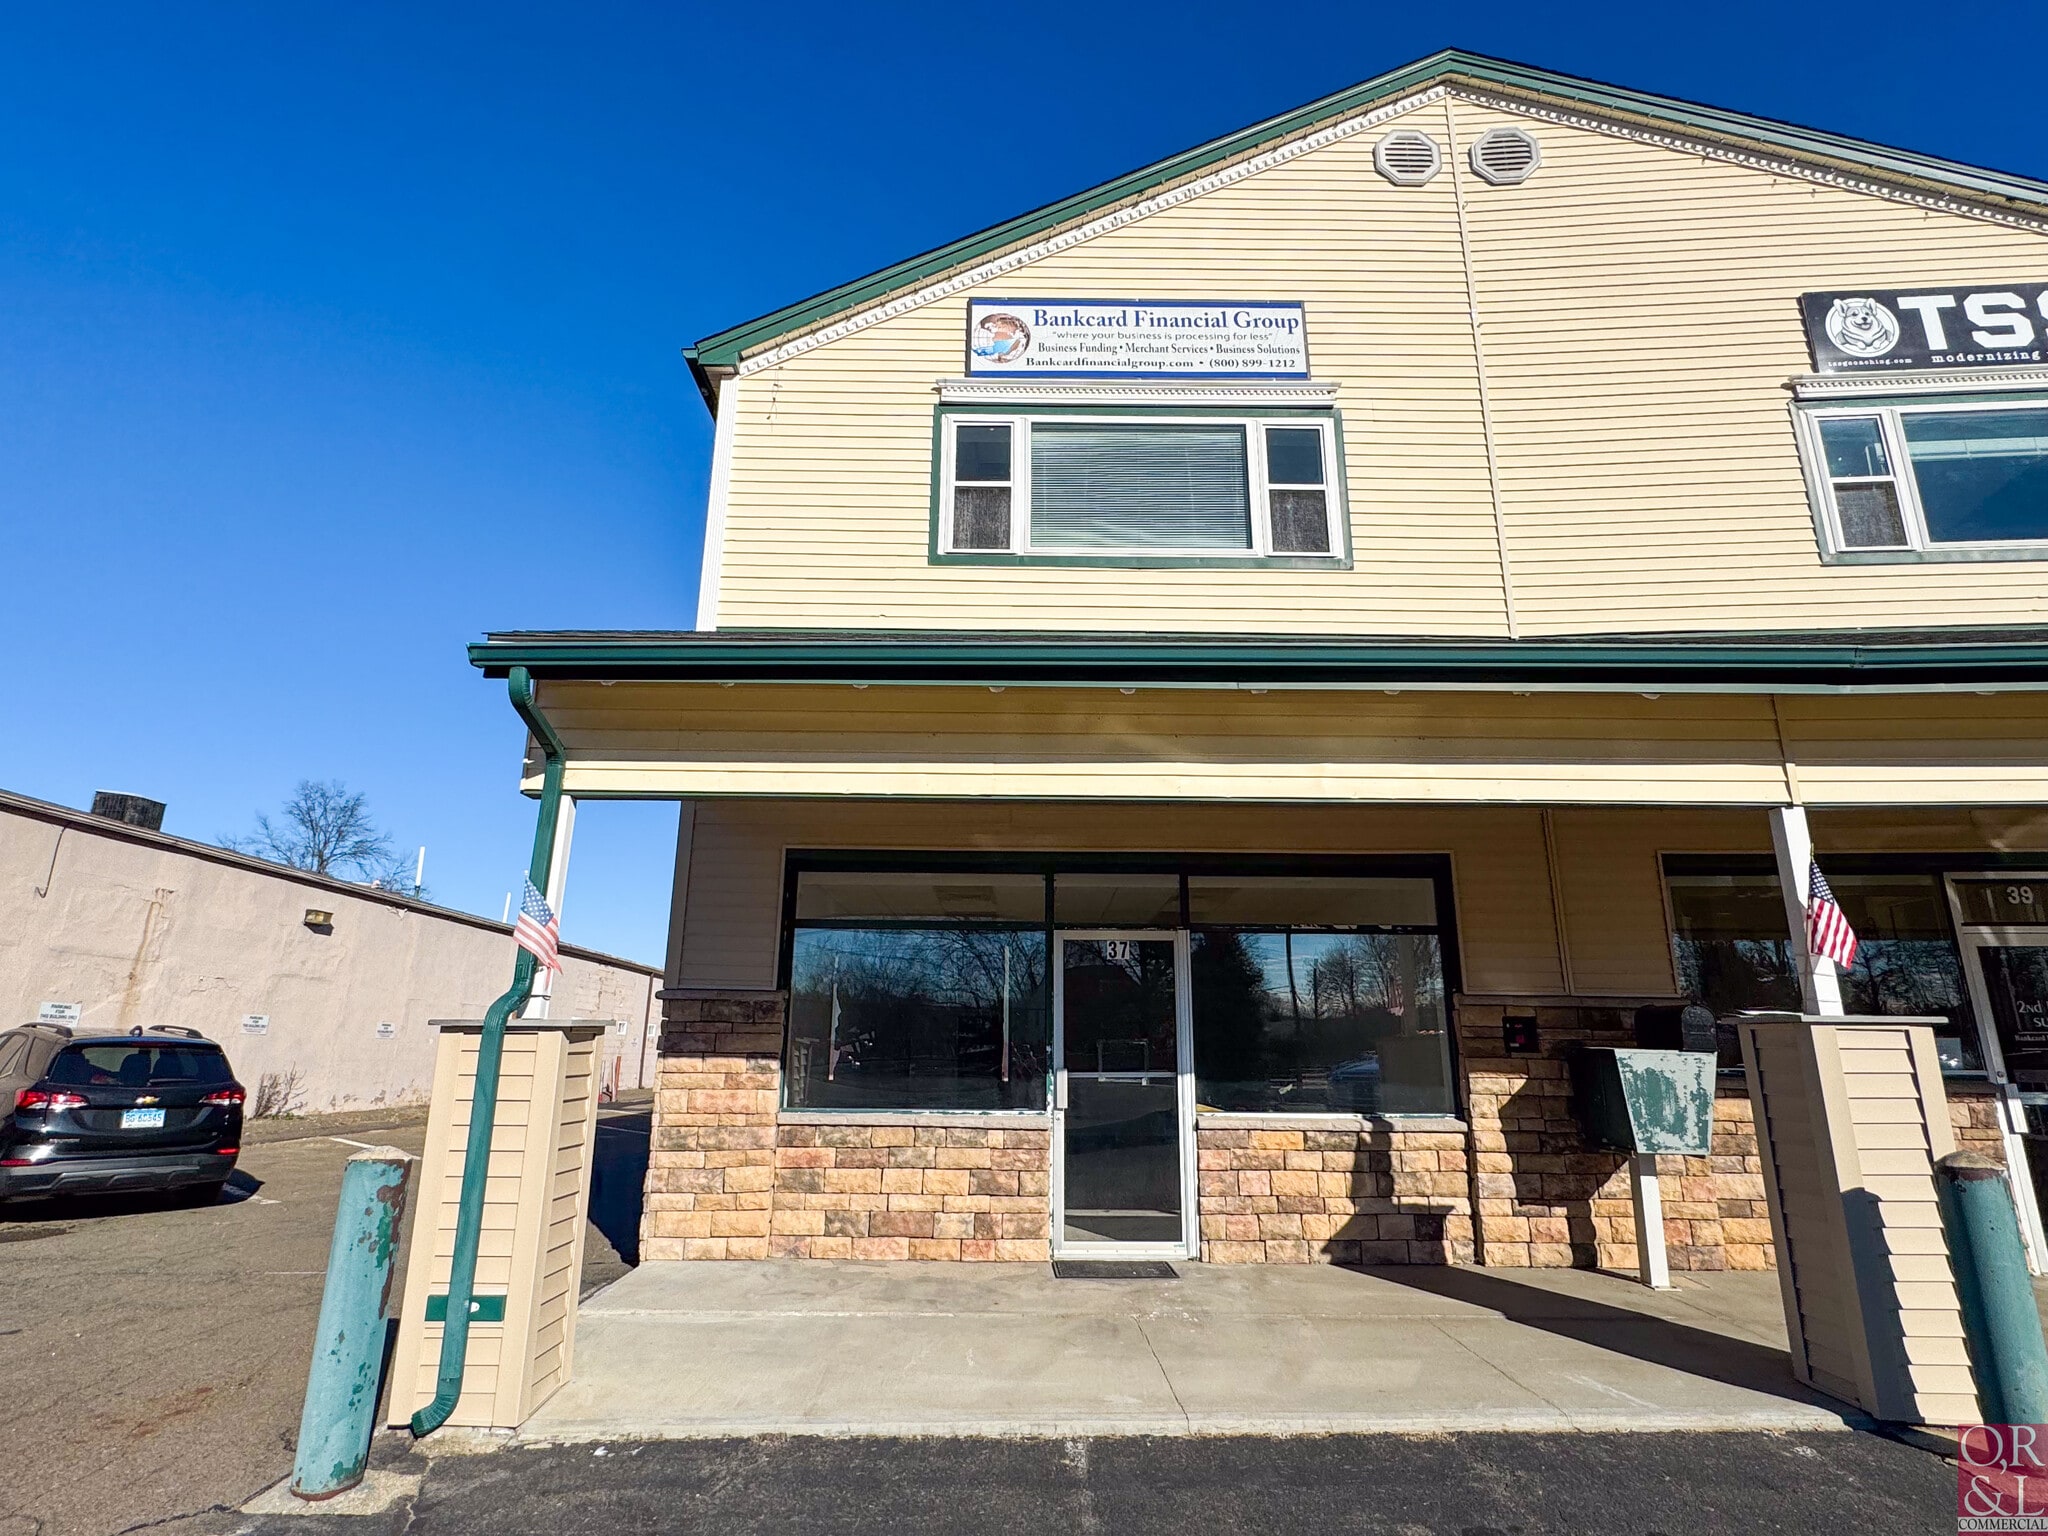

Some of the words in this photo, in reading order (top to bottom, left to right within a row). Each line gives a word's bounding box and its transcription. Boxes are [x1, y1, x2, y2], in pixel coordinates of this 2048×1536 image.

[1033, 309, 1127, 327] Bankcard
[1134, 310, 1227, 328] Financial
[1233, 311, 1299, 334] Group
[1897, 290, 2048, 350] TS
[1091, 332, 1114, 341] your
[1117, 331, 1162, 341] business
[1164, 332, 1172, 341] is
[1175, 333, 1230, 343] processing
[1233, 332, 1247, 341] for
[1038, 342, 1077, 353] Business
[1080, 342, 1118, 355] Funding
[1125, 343, 1169, 354] Merchant
[1171, 343, 1209, 354] Services
[1216, 344, 1255, 355] Business
[1257, 344, 1300, 355] Solutions
[1026, 357, 1194, 369] Bankcardfinancialgroup.com
[1209, 358, 1239, 369] (800)
[1242, 358, 1296, 368] 899-1212
[1931, 351, 2041, 363] modernizing
[2006, 886, 2033, 904] 39
[1108, 942, 1128, 958] 37
